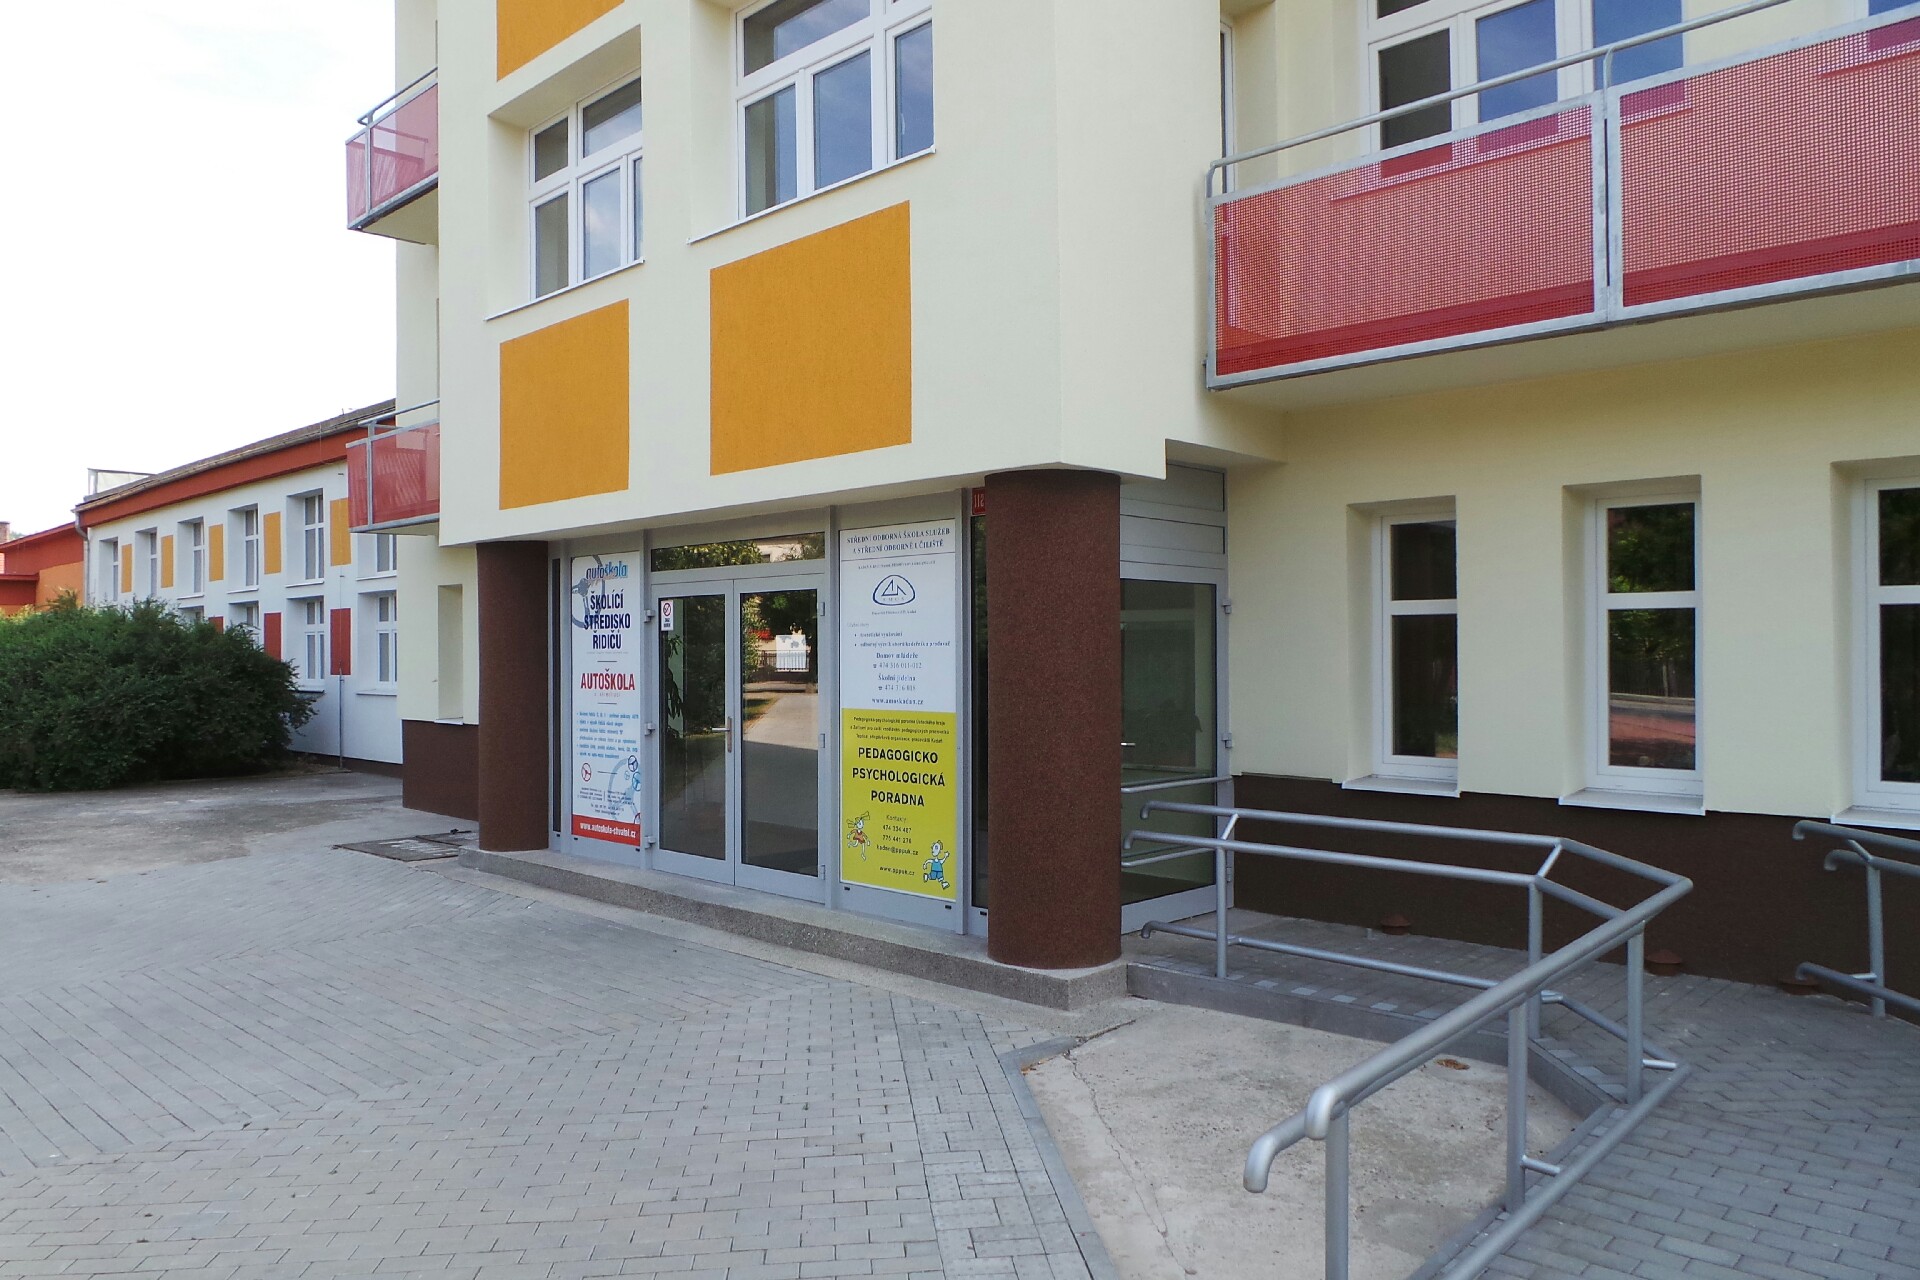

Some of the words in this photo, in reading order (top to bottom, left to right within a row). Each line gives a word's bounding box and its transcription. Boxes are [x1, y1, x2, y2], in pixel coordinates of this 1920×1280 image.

[847, 534, 872, 544] STŘEDNÍ
[873, 531, 902, 542] ODBORNÁ
[903, 530, 924, 539] ŠKOLA
[925, 527, 950, 536] SLUŽEB
[857, 545, 882, 554] STŘEDNÍ
[883, 541, 913, 552] ODBORNÉ
[914, 538, 944, 549] UČILIŠTĚ
[586, 560, 628, 579] autoškola
[590, 589, 624, 610] ŠKOLÍCÍ
[584, 611, 631, 630] STŘEDISKO
[593, 630, 622, 650] ŘIDIČŮ
[580, 668, 636, 690] AUTOŠKOLA
[878, 673, 896, 681] Školní
[858, 747, 938, 763] PEDAGOGICKO
[852, 767, 945, 787] PSYCHOLOGICKÁ
[871, 790, 925, 807] PORADNA
